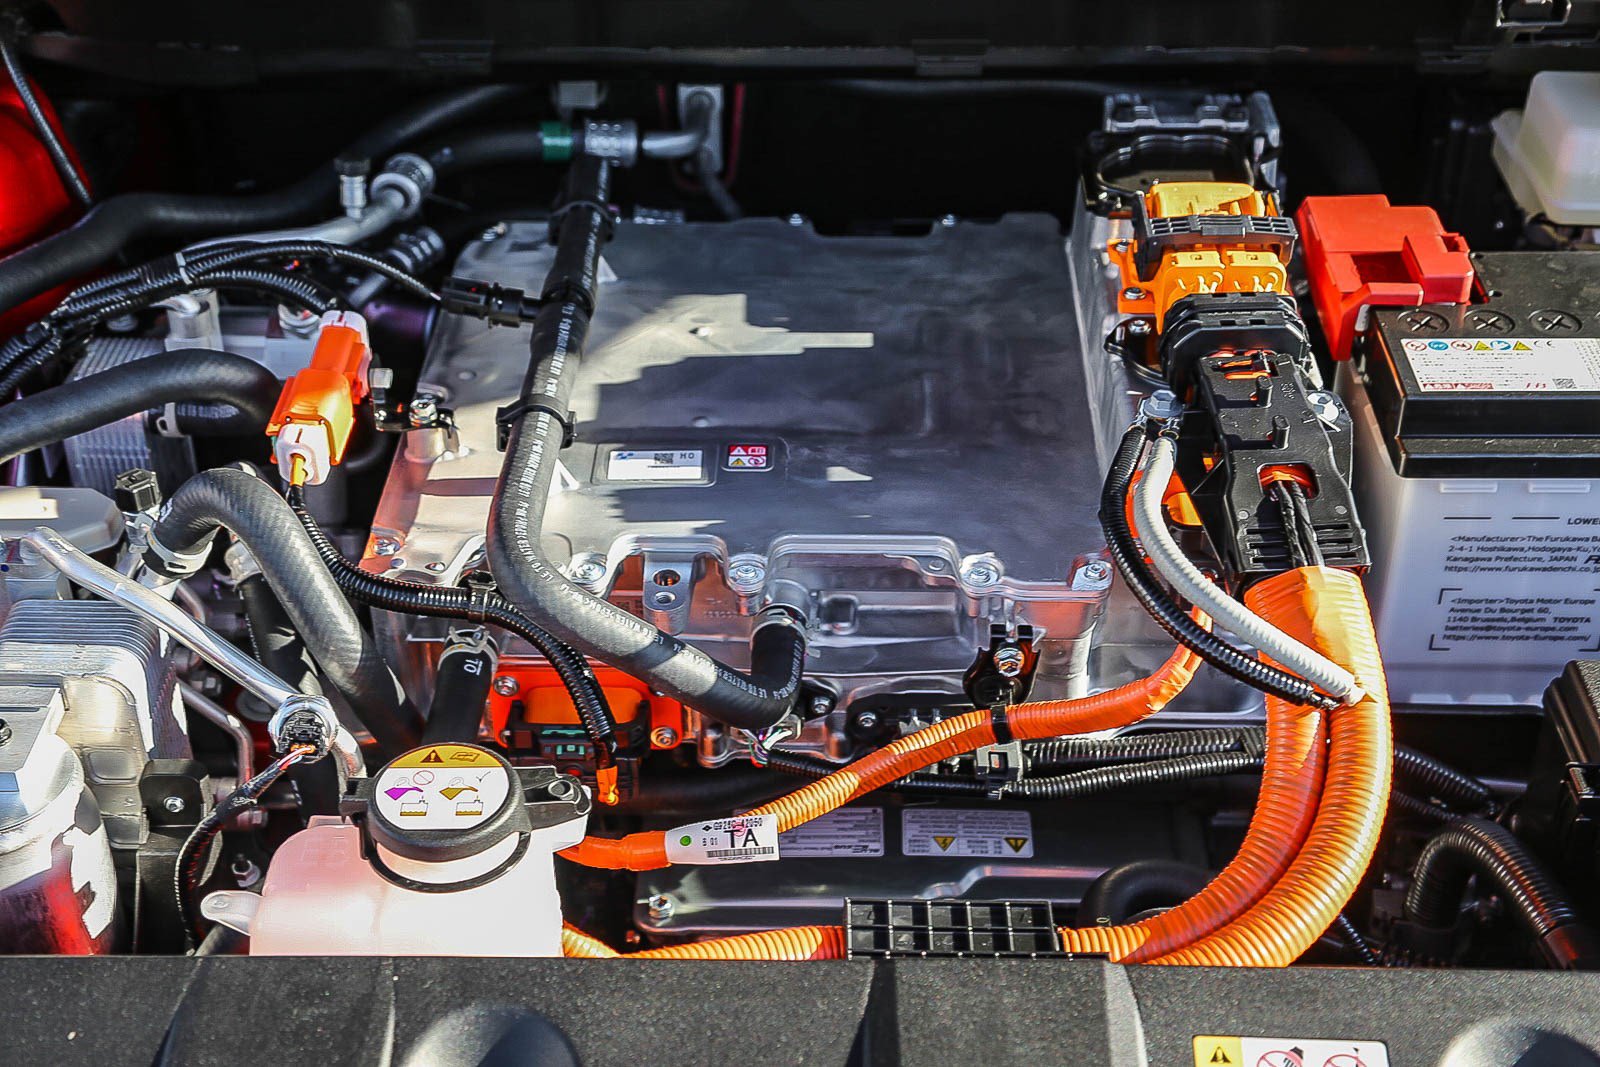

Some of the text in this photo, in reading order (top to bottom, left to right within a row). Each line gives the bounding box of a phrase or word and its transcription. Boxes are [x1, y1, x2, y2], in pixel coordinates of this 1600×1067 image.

[1567, 517, 1600, 526] LOWE
[1446, 555, 1492, 564] Kanagawa
[1548, 555, 1578, 563] JAPAN
[1536, 597, 1561, 605] Motor
[1563, 598, 1596, 606] Europe
[1552, 616, 1591, 624] TOYOTA
[723, 828, 760, 848] TA
